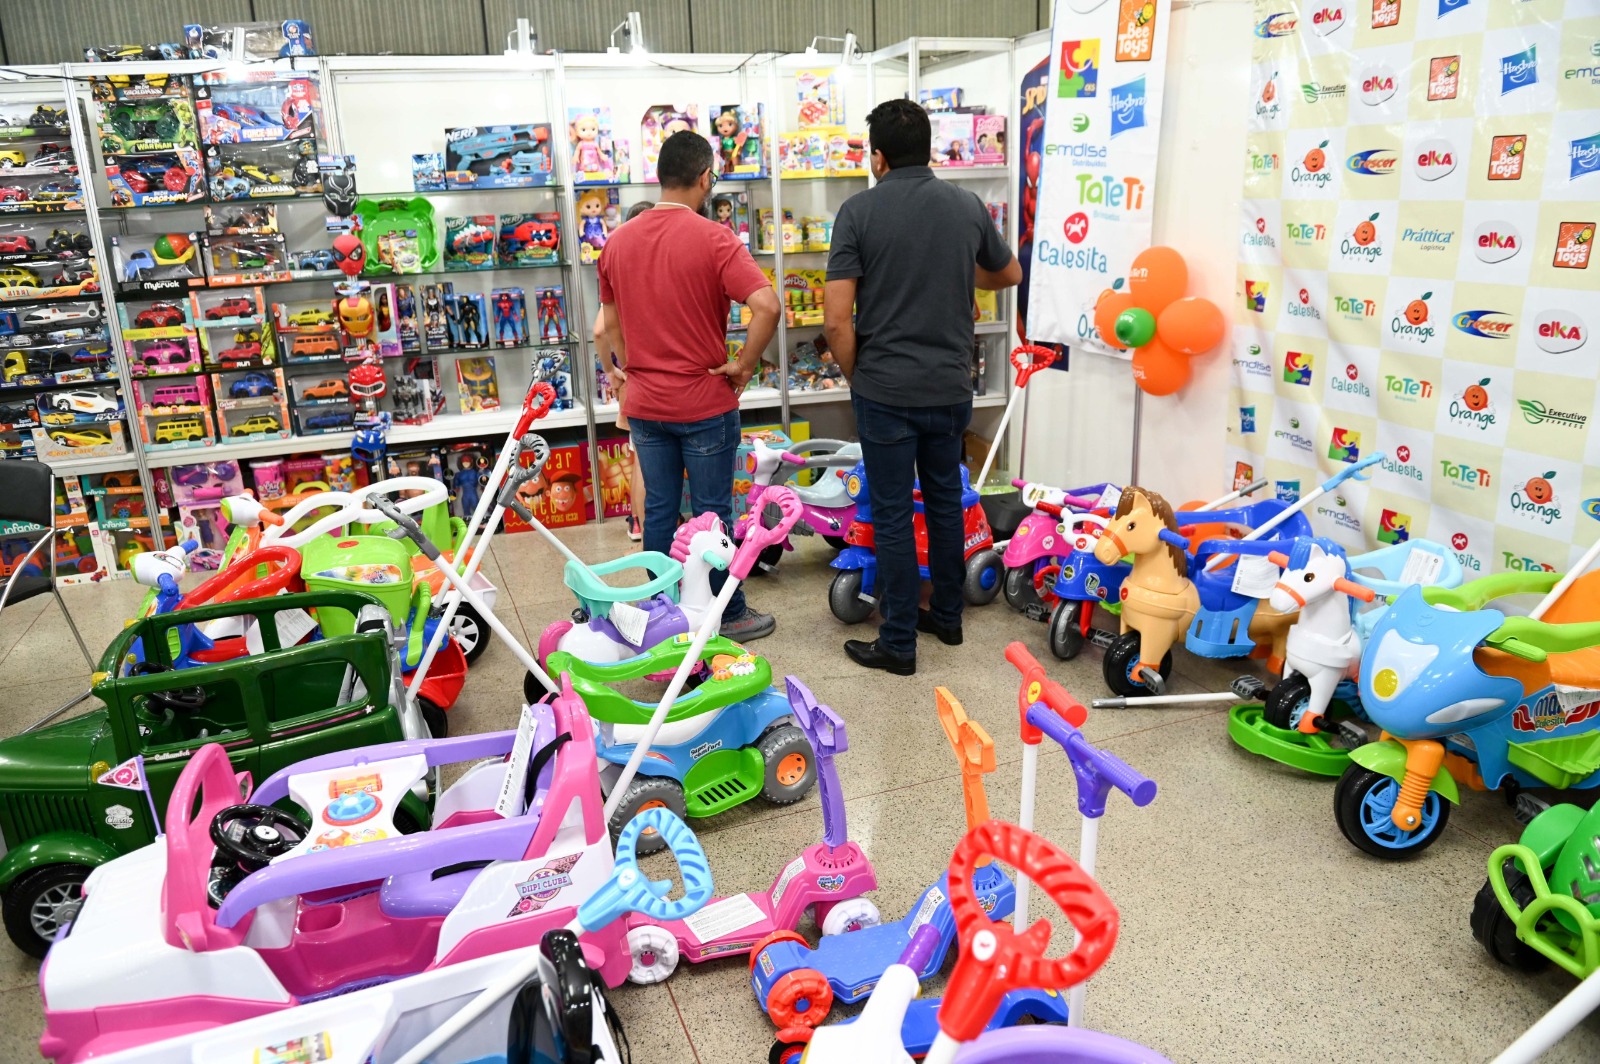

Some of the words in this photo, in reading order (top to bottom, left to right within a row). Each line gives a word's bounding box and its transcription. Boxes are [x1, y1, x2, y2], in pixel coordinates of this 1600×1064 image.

[1380, 2, 1398, 12] Bee
[1372, 10, 1397, 25] Toys
[1127, 22, 1150, 39] Bee
[1118, 34, 1149, 58] Toys
[1500, 61, 1537, 75] Hasbro
[1437, 74, 1456, 85] Bee
[1430, 81, 1456, 97] Toys
[1109, 92, 1147, 112] Hasbro
[445, 126, 478, 141] NERF
[1045, 143, 1107, 158] emdisa
[1251, 154, 1279, 170] TaTeTi
[1351, 156, 1398, 169] Crescer
[1501, 153, 1519, 166] Bee
[1291, 167, 1332, 188] Orange
[1491, 161, 1519, 178] Toys
[1076, 174, 1146, 211] TaTeTi
[446, 219, 468, 228] NERF
[501, 215, 524, 225] NERF
[1286, 223, 1326, 240] TaTeTi
[1401, 227, 1452, 244] Práttica
[1341, 239, 1383, 262] Orange
[1567, 240, 1587, 253] Bee
[1038, 240, 1108, 274] Calesita
[1557, 247, 1586, 266] Toys
[144, 281, 180, 291] Mytruck
[1287, 302, 1321, 320] Calesita
[1334, 296, 1376, 317] TaTeTi
[1391, 317, 1435, 343] Orange
[1456, 314, 1514, 333] Crescer
[1331, 376, 1371, 397] Calesita
[1385, 375, 1433, 399] TaTeTi
[1449, 401, 1496, 430] Orange
[1545, 418, 1584, 429] EXPRESS
[1547, 408, 1587, 422] Executiva
[1381, 456, 1423, 481] Calesita
[1440, 460, 1491, 487] TaTeTi
[86, 488, 106, 496] infanto
[1510, 492, 1562, 525] Orange
[3, 522, 41, 534] infanto
[690, 743, 707, 755] Super
[521, 883, 541, 894] DIIPI
[542, 876, 568, 888] CLUBE
